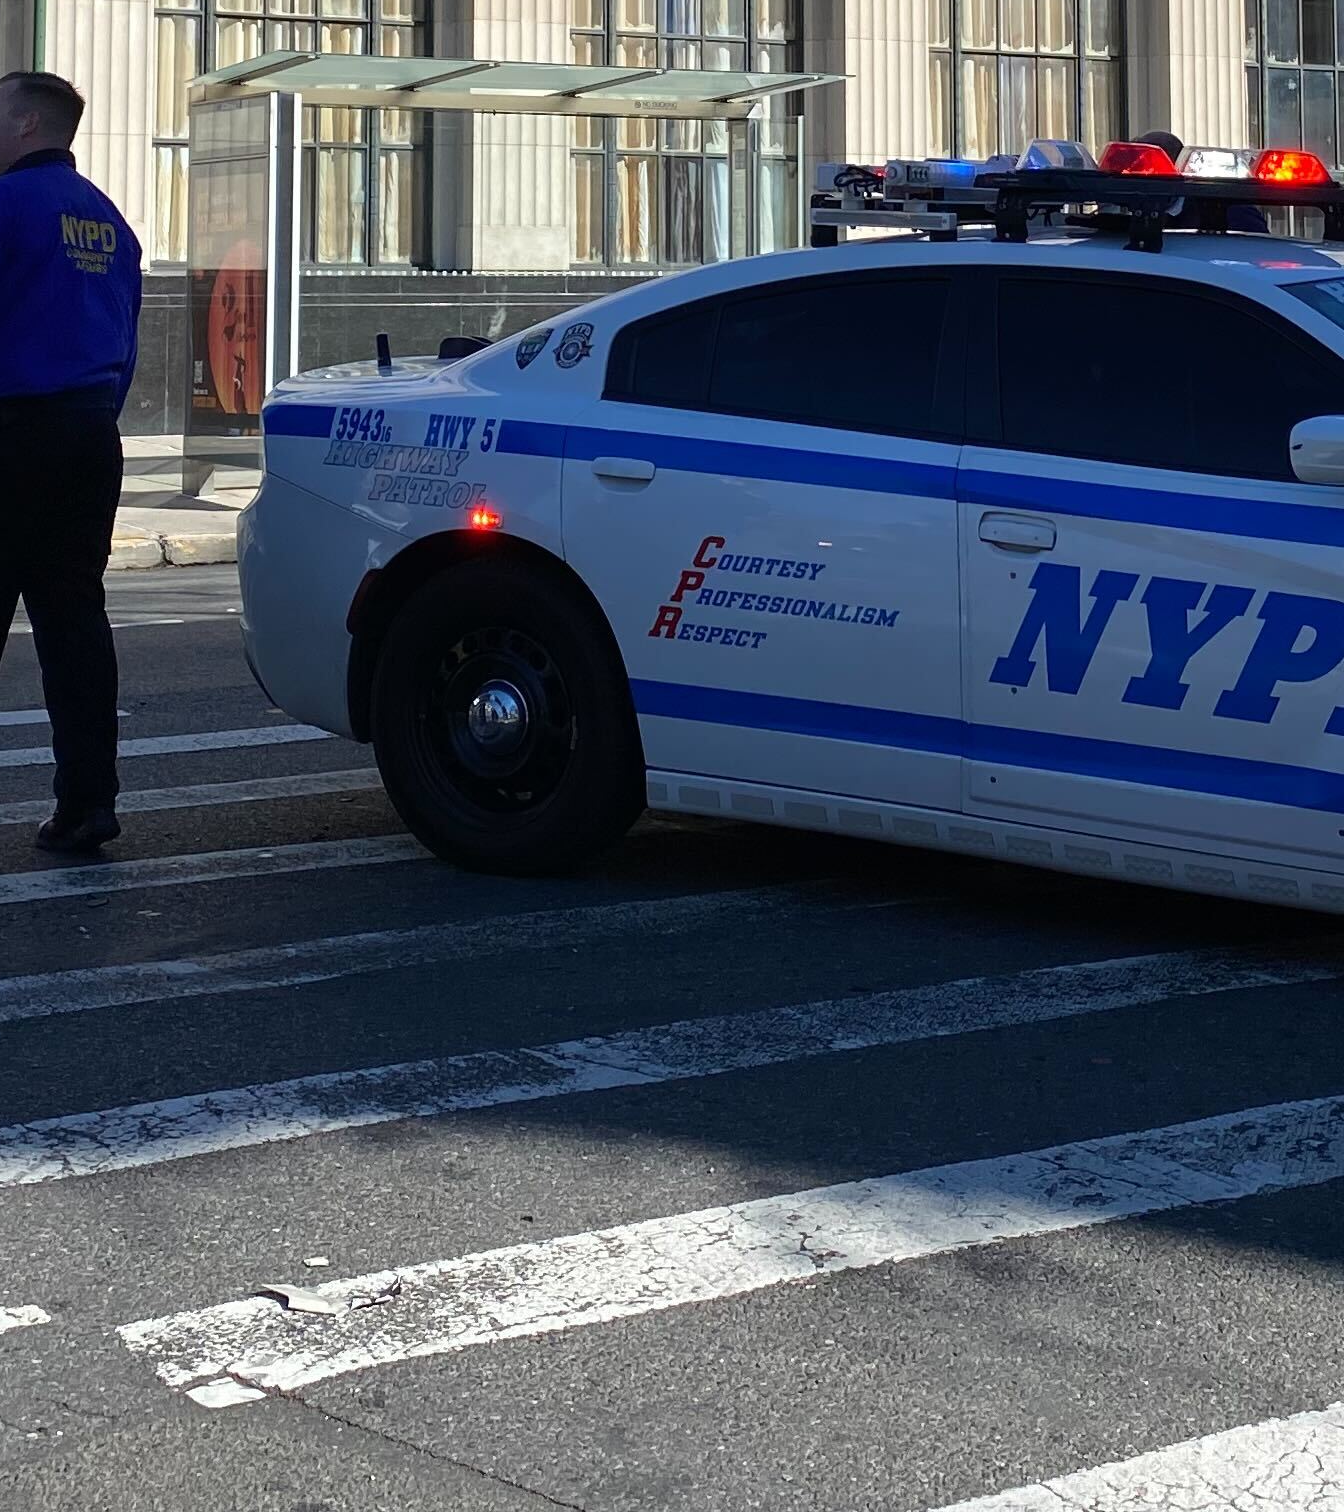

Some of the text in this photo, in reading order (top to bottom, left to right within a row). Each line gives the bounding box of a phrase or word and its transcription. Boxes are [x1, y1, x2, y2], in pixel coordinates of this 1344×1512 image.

[61, 213, 117, 253] NYPD
[335, 406, 386, 442] 5943
[422, 413, 497, 453] HWY 5
[322, 439, 470, 477] HIGHWAY
[367, 473, 488, 511] PATROL
[692, 535, 826, 581] COURTESY
[669, 570, 900, 628] PROFESSIONALISM
[647, 604, 768, 650] RESPECT
